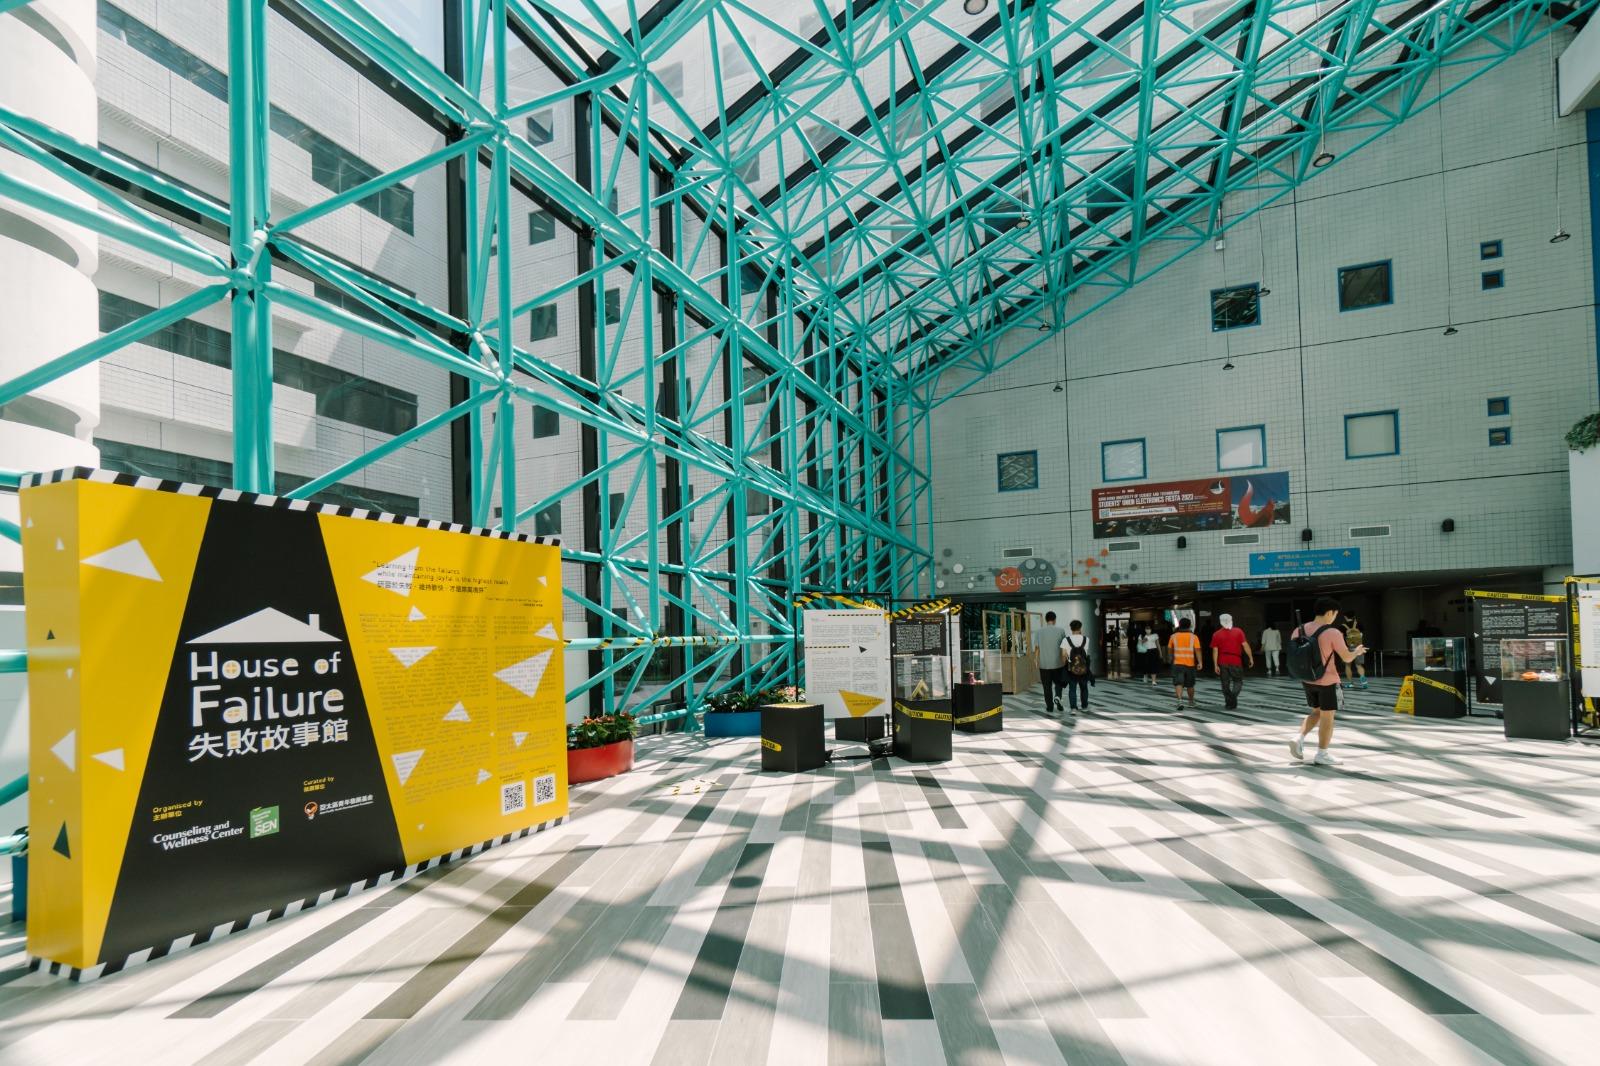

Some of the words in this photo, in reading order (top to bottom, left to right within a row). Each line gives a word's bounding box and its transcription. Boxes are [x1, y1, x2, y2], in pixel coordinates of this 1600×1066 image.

[1136, 496, 1164, 504] ELECTRONICS
[1165, 494, 1180, 502] FIESTA
[1000, 573, 1052, 586] Science
[190, 651, 299, 681] House
[314, 651, 342, 675] of
[192, 684, 345, 727] Failure
[188, 718, 349, 763] 失敗故事館
[304, 777, 326, 786] Curated
[152, 801, 192, 814] Organised
[153, 825, 212, 844] Counseling
[213, 820, 230, 831] and
[254, 818, 278, 837] SEN
[162, 834, 209, 851] Wellness
[211, 826, 244, 840] Center
